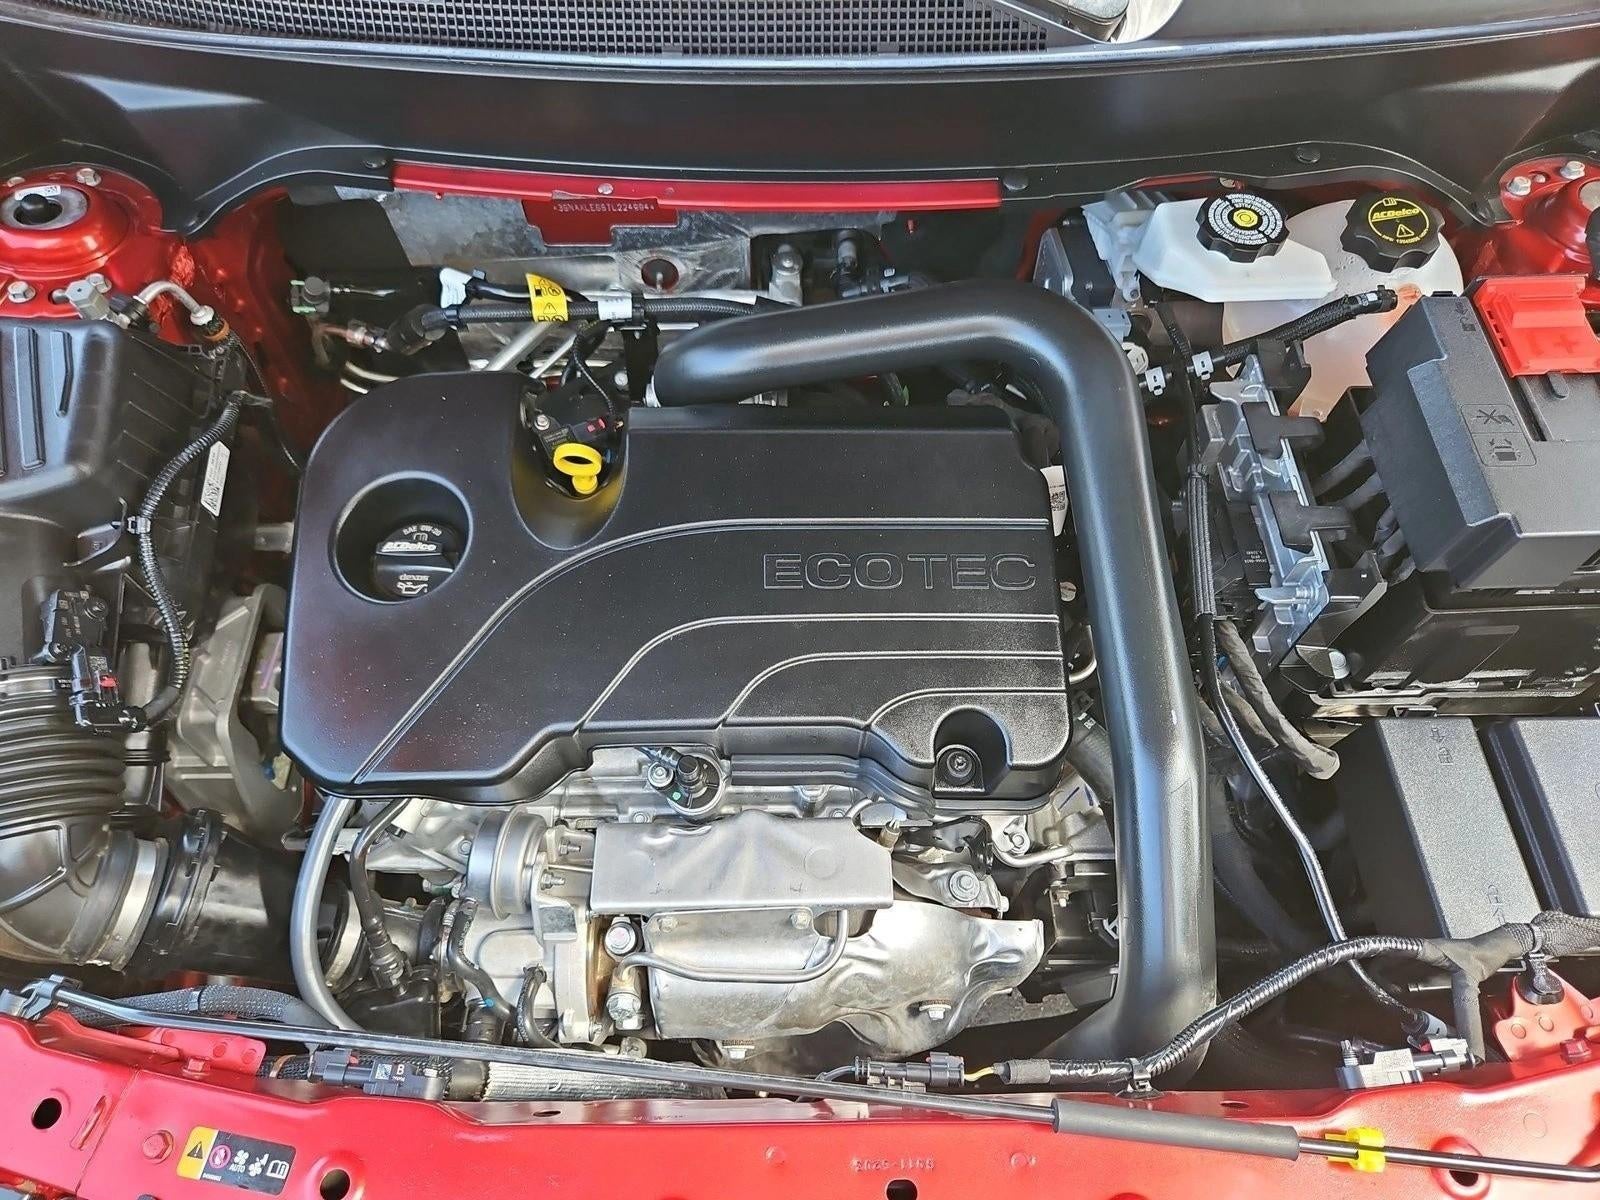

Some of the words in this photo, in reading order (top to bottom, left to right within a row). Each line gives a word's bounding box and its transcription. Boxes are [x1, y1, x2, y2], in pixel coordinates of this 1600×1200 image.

[1371, 208, 1420, 221] ACDelco
[763, 553, 1037, 591] ECOTEC
[396, 1064, 405, 1075] B
[229, 1163, 246, 1173] AUTO
